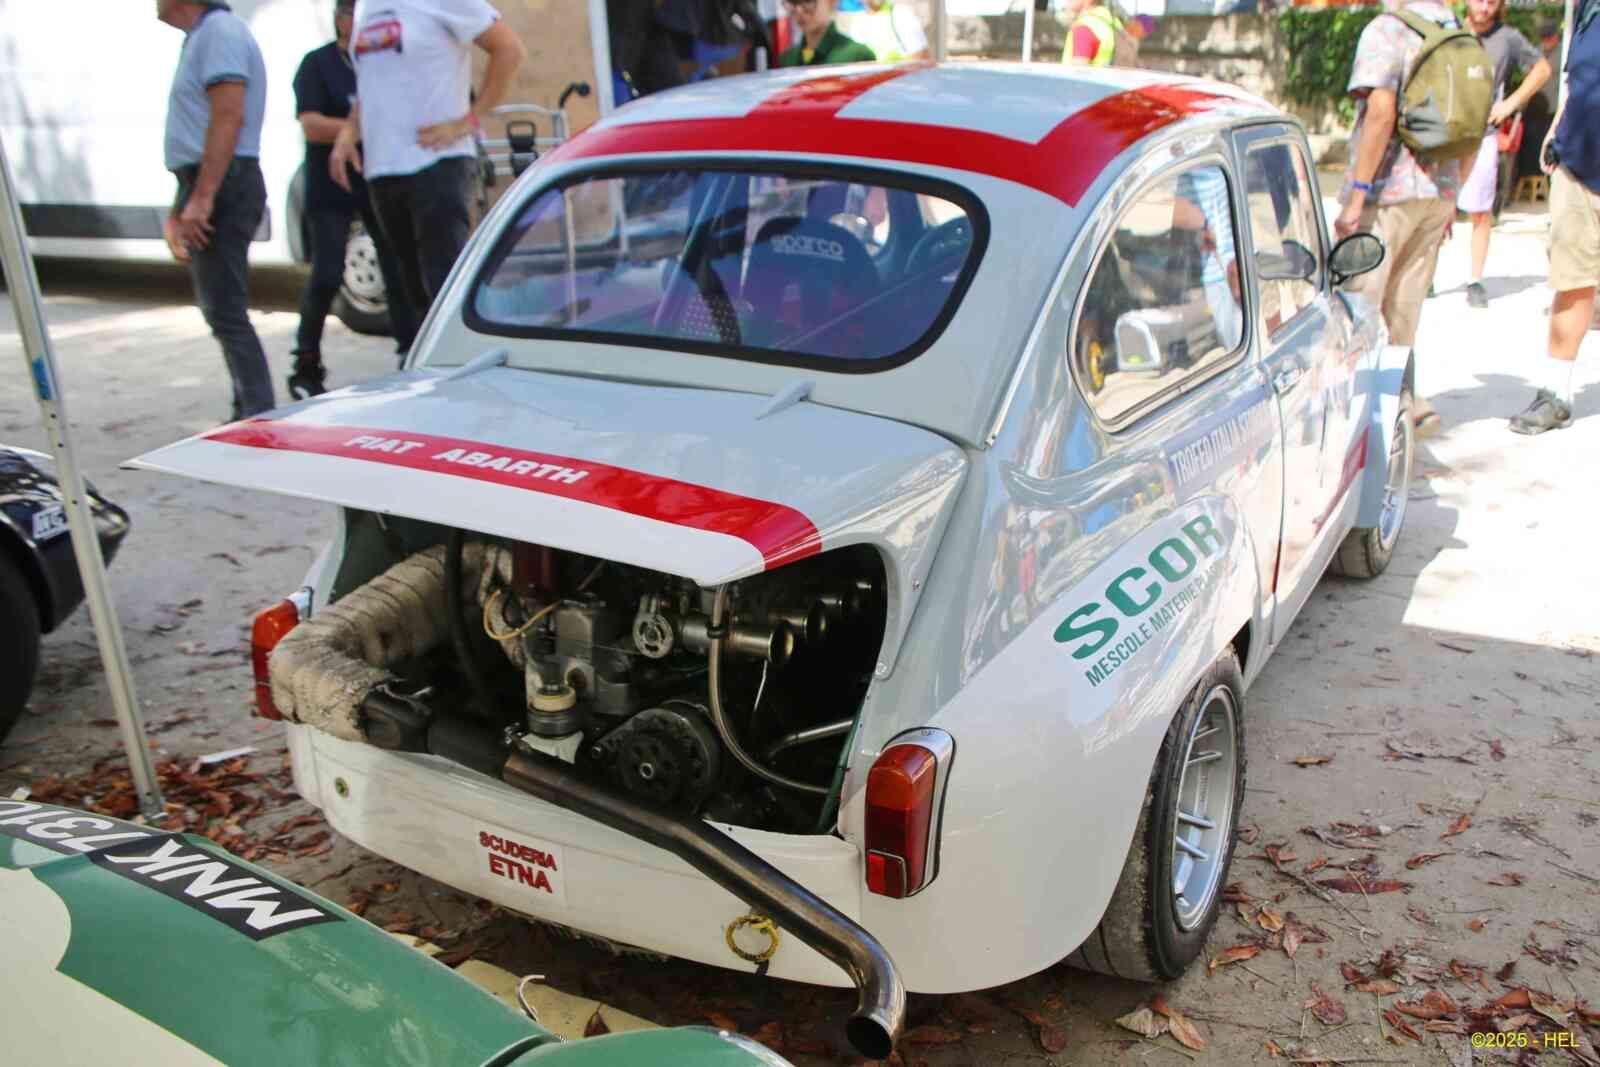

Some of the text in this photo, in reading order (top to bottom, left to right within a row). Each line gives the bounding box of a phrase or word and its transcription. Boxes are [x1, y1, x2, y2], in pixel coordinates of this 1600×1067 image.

[344, 435, 589, 484] FIAT ABARTH
[1053, 514, 1224, 660] SCOR
[1084, 622, 1152, 687] MESCOLE
[1148, 583, 1199, 632] MATERIE
[104, 838, 325, 930] MNK
[479, 831, 557, 871] SCUDERIA
[489, 852, 553, 894] ETNA
